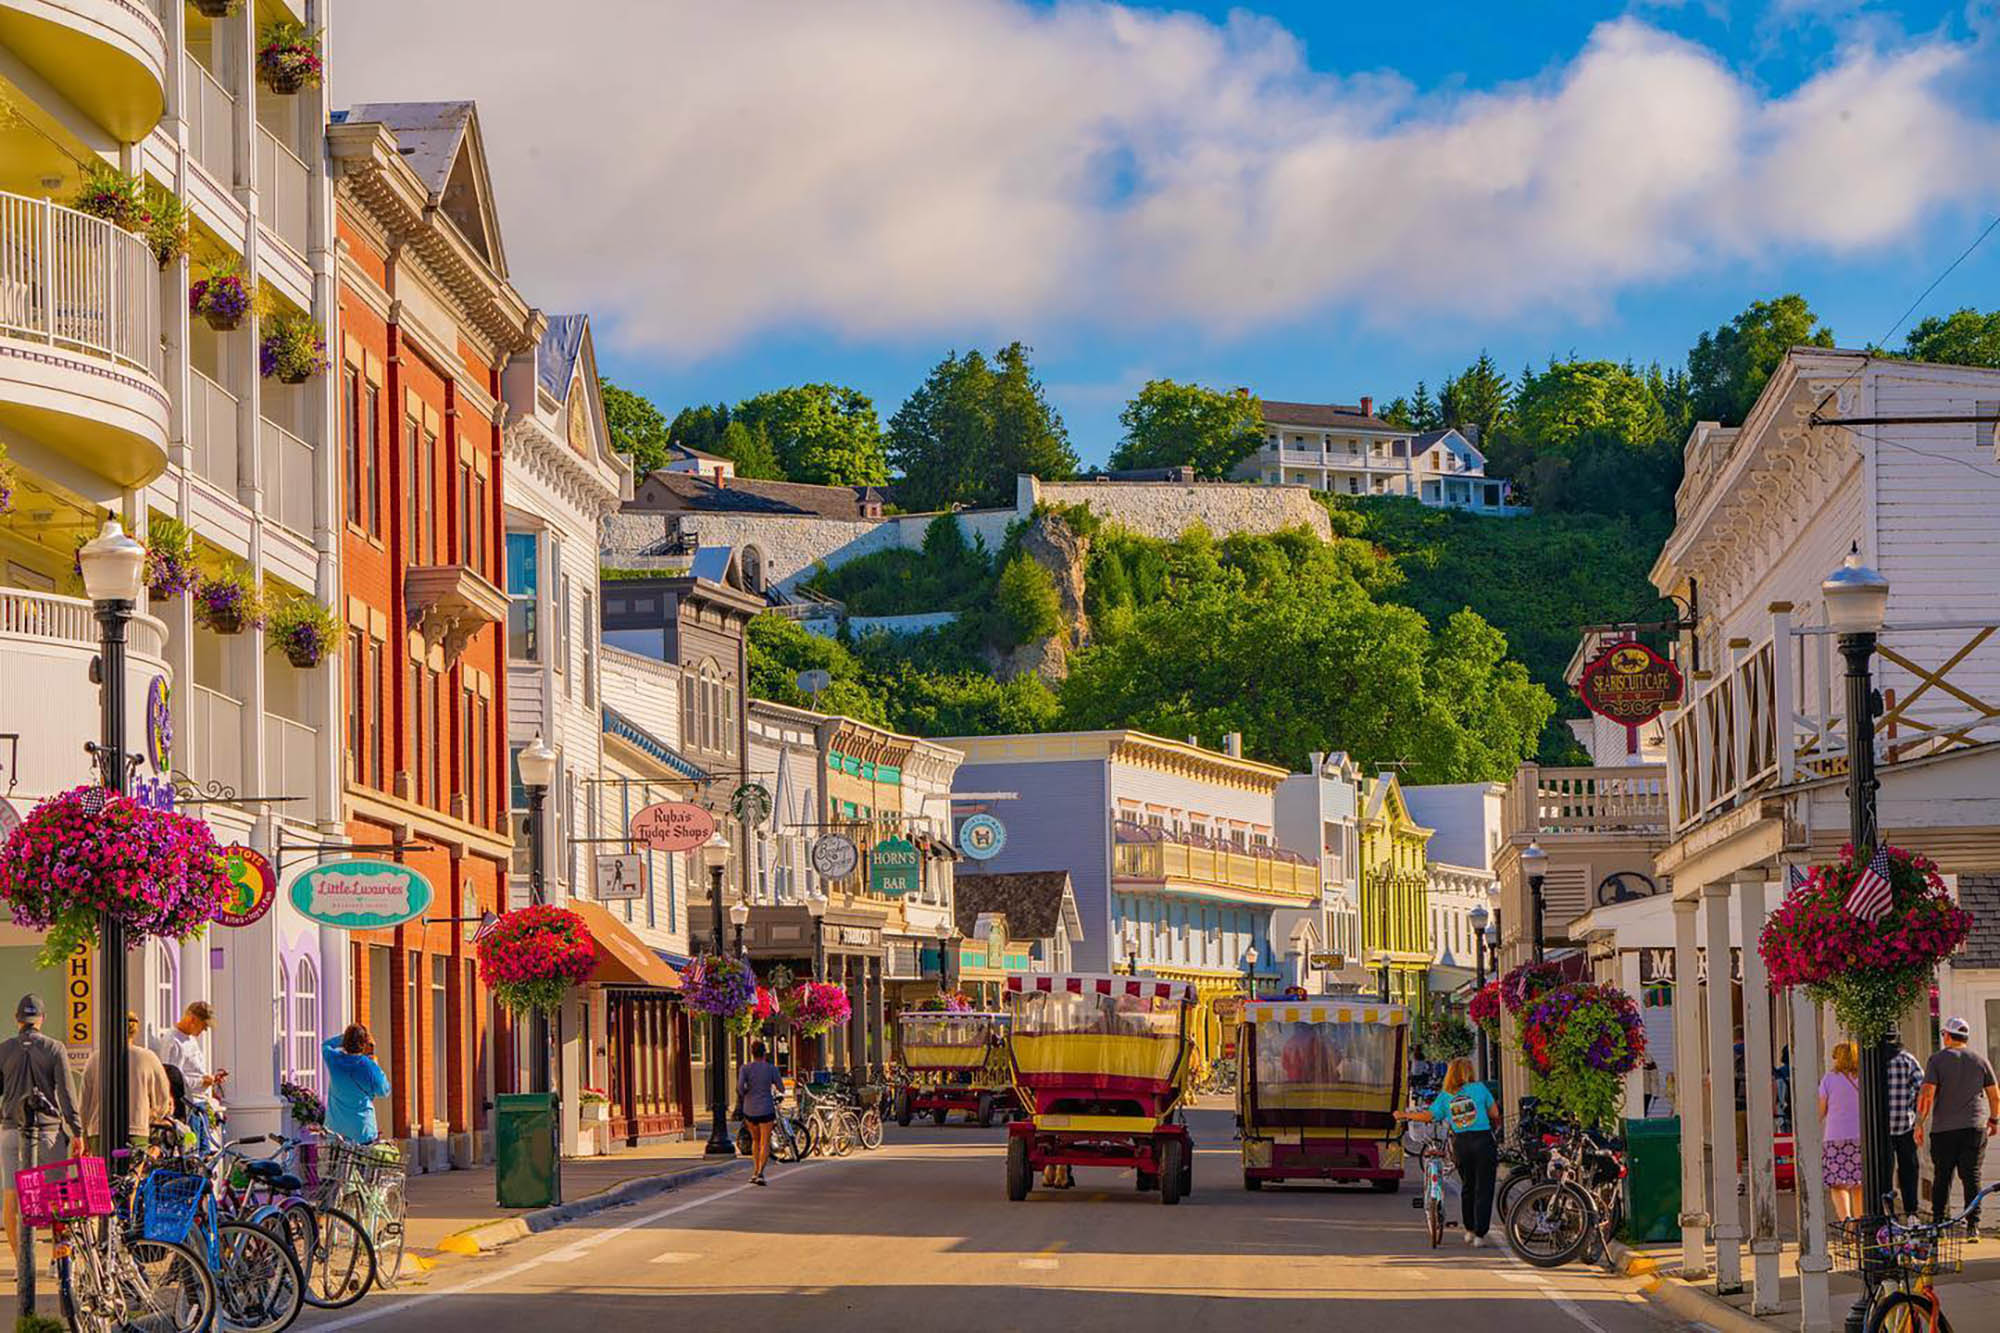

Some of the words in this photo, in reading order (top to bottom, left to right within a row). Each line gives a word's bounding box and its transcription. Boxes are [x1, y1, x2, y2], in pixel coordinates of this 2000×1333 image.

[654, 807, 692, 826] Ryba's
[635, 824, 671, 841] Fudge
[672, 824, 709, 841] Shops
[873, 852, 916, 865] HORN'S
[317, 880, 352, 895] Little
[883, 877, 906, 889] BAR
